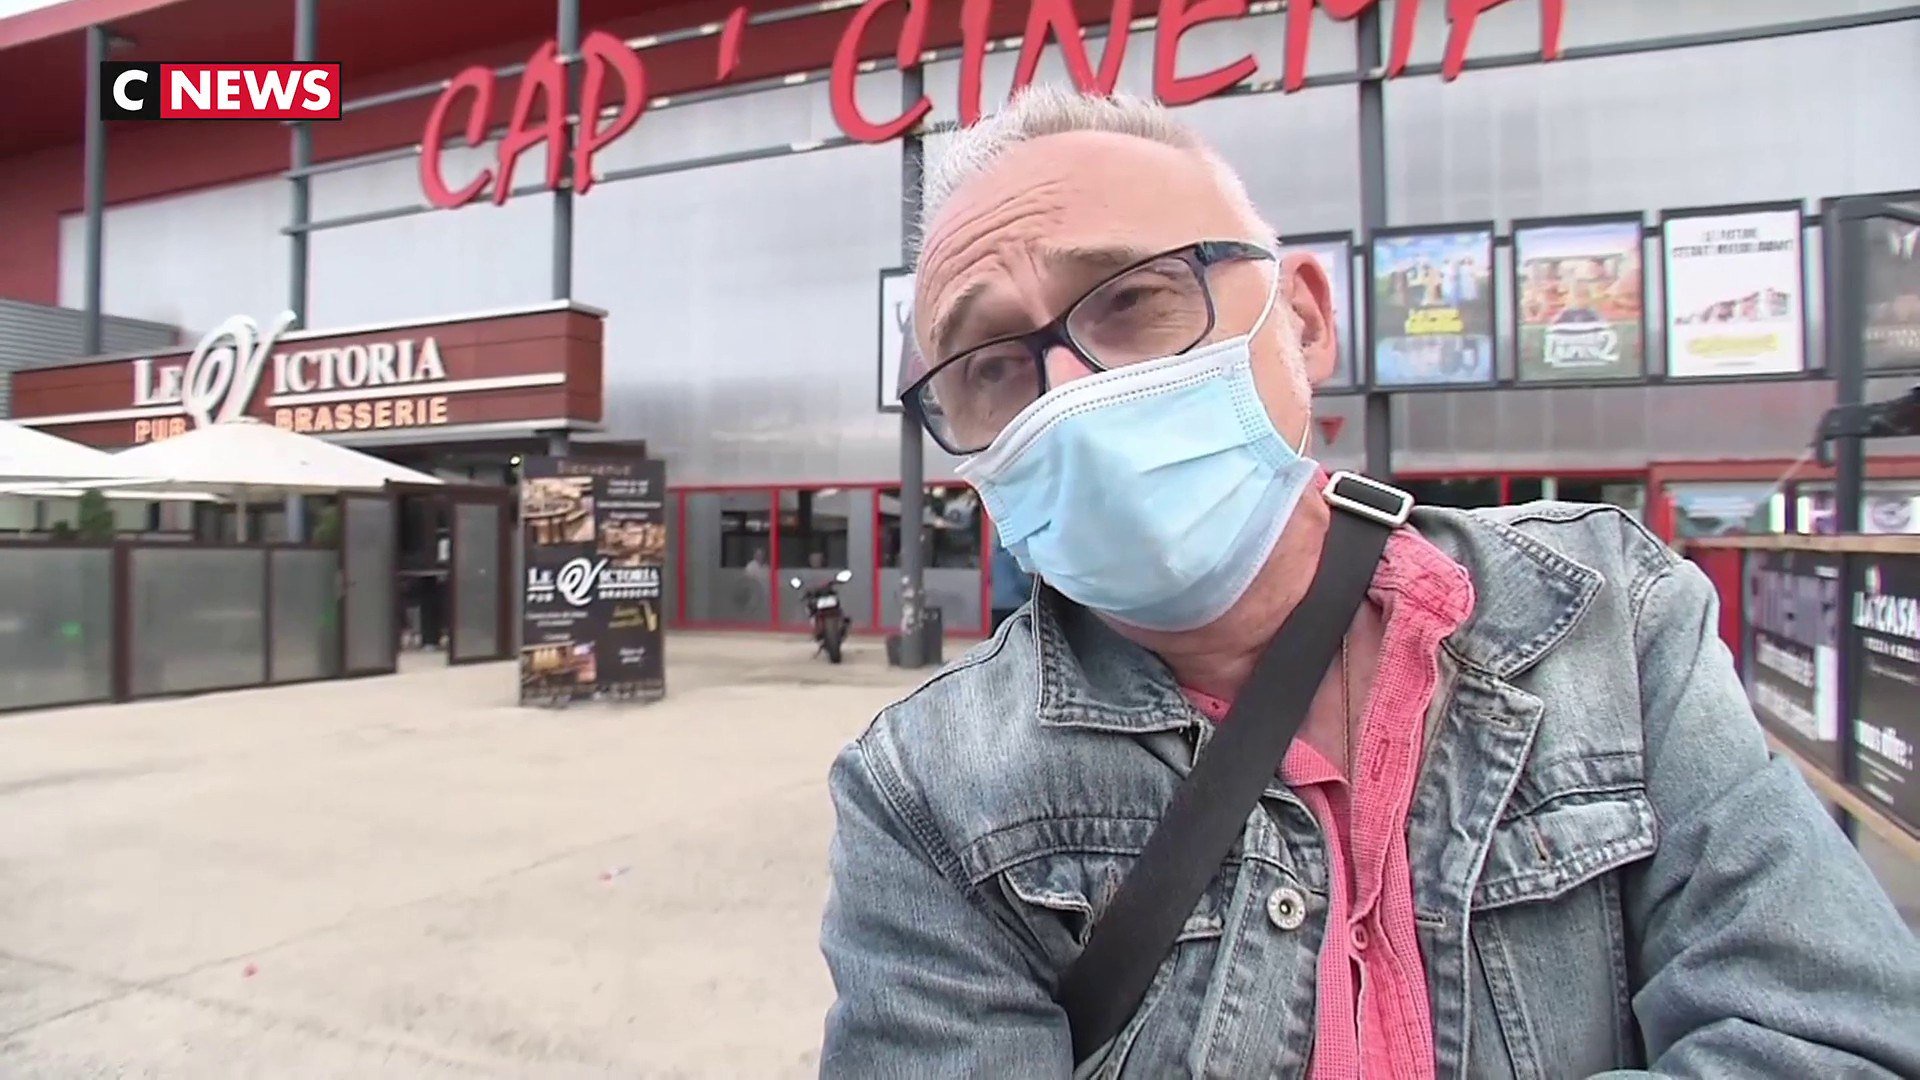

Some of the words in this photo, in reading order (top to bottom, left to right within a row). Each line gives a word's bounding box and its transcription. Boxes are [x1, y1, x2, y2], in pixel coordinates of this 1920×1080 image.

[417, 30, 647, 209] CAP
[133, 418, 187, 443] PUB
[274, 397, 449, 433] BRASSERIE
